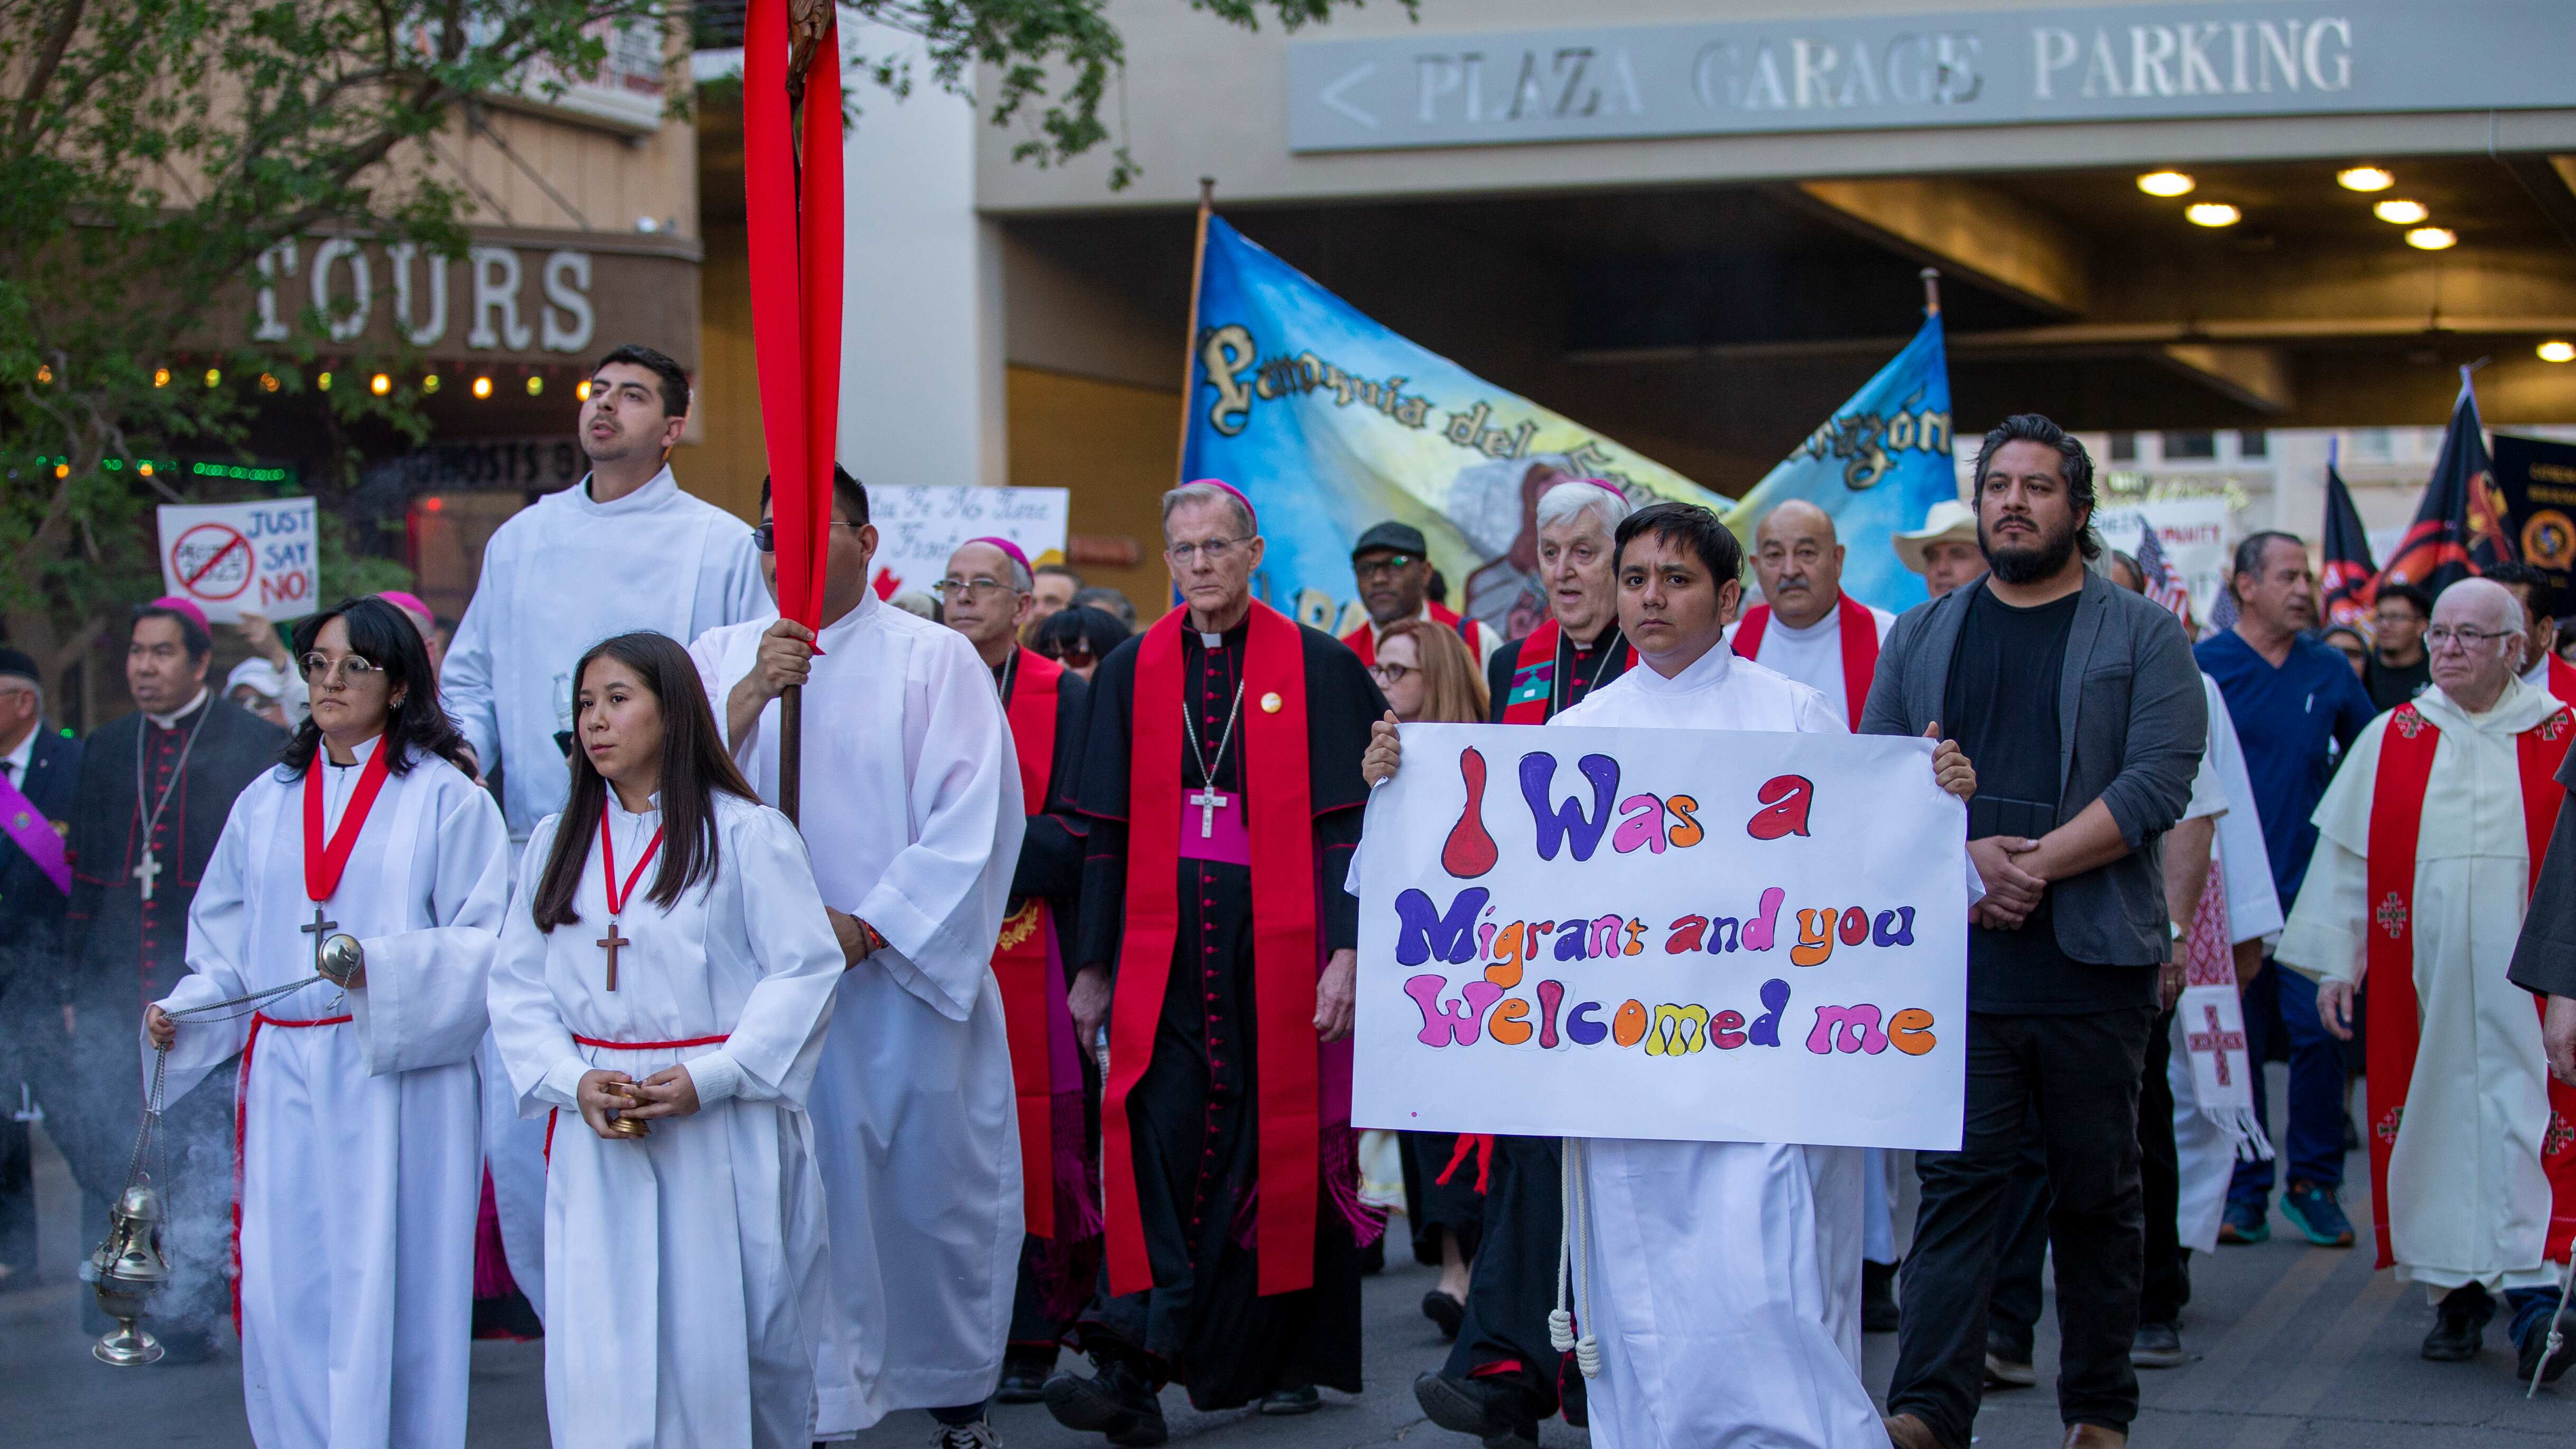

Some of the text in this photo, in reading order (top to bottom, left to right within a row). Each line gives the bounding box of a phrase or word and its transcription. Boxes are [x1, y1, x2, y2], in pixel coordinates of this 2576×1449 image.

[1412, 17, 2353, 124] PLAZA GARAGE PARKING
[253, 236, 595, 352] TOURS
[1442, 399, 1538, 459] del
[245, 509, 309, 539] JUST
[263, 543, 309, 571] SAY
[1441, 745, 1812, 879] I Was a
[1395, 887, 1916, 990] Migrant and you
[1403, 974, 1938, 1057] Welcomed me
